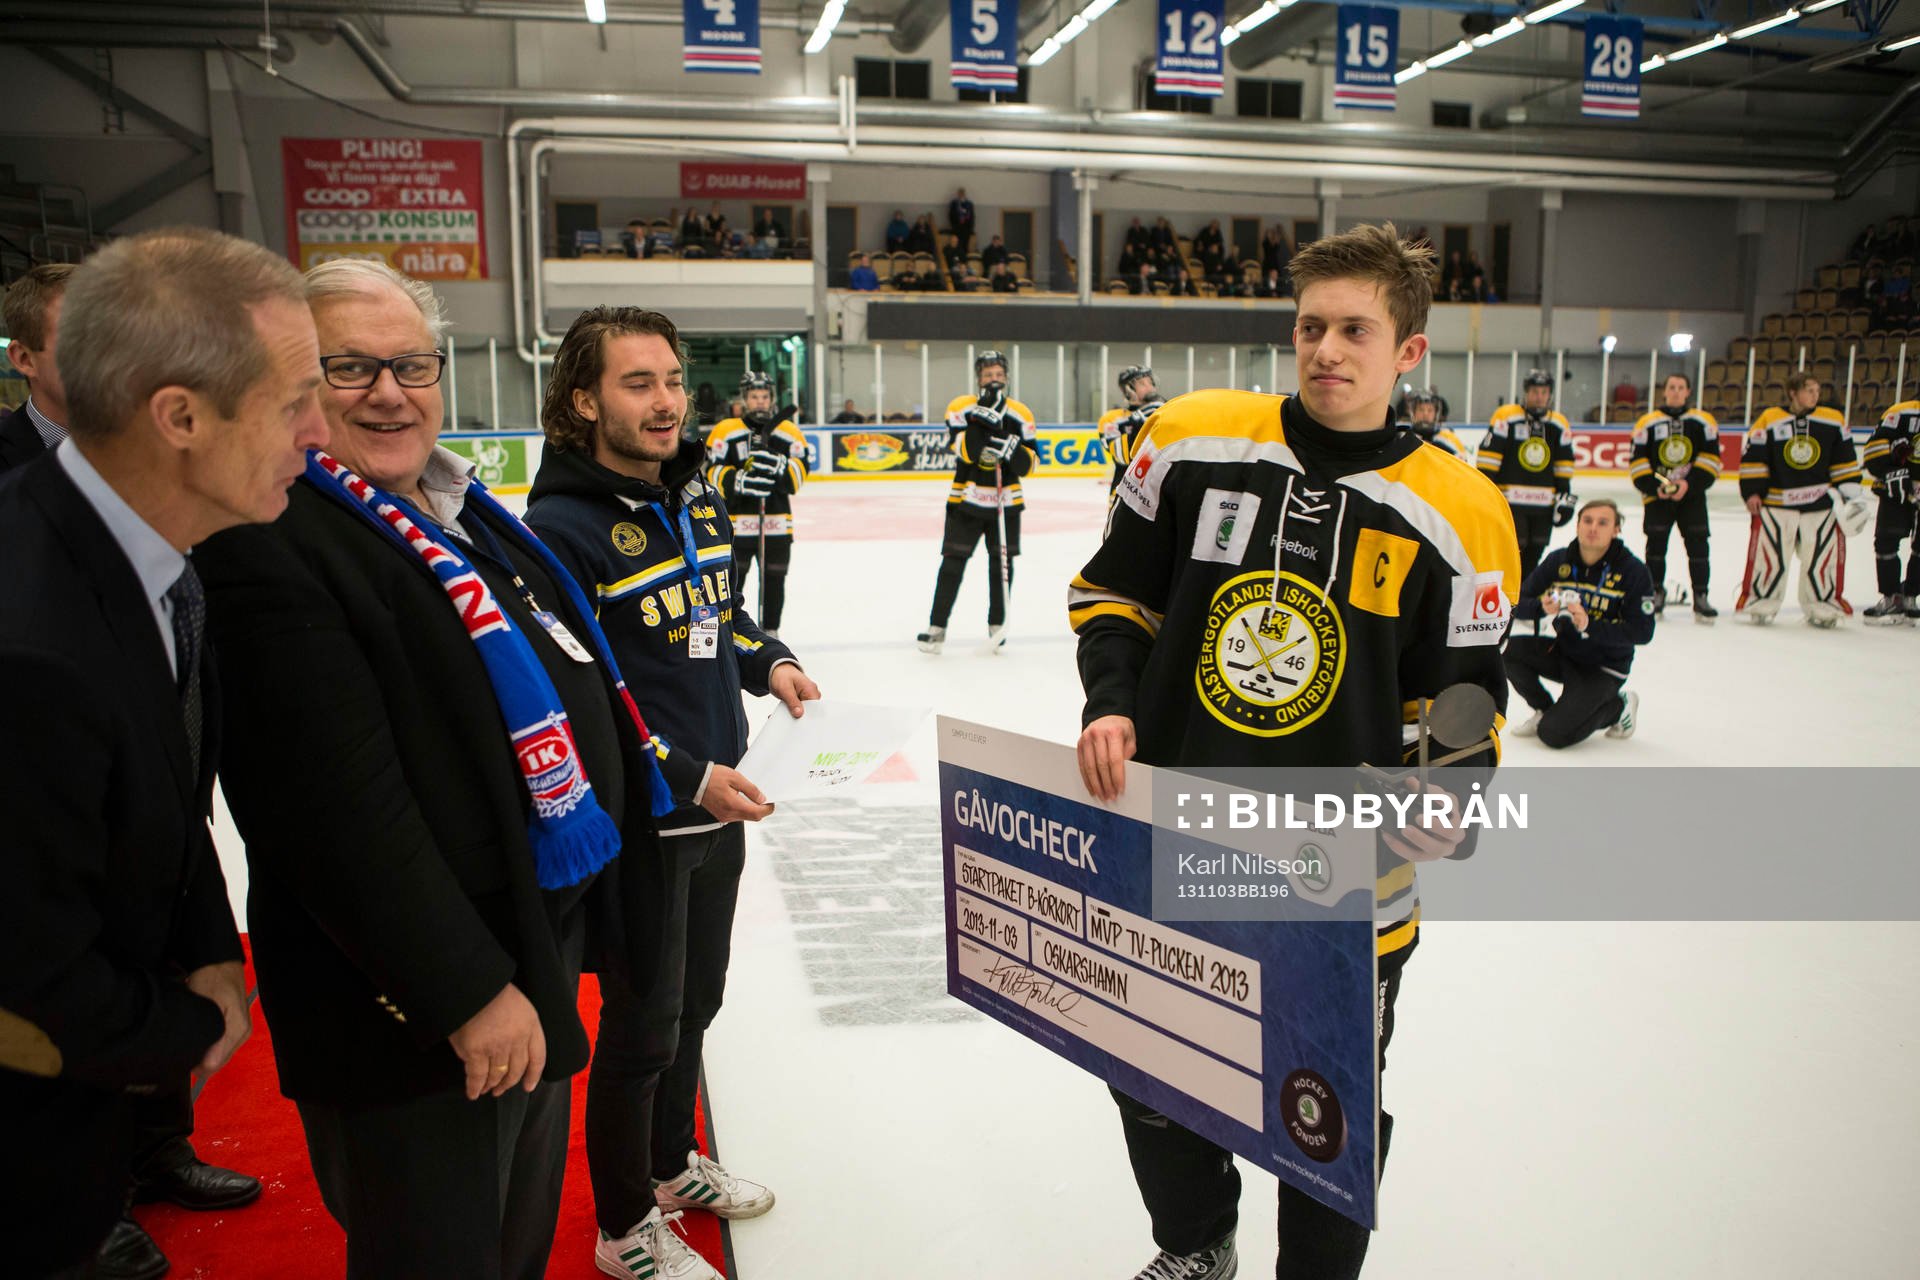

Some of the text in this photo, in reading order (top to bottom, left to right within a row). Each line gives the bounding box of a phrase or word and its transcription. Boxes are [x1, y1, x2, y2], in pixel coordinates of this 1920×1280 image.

[703, 0, 736, 26] 4
[971, 0, 999, 45] 5
[1165, 9, 1217, 55] 12
[1345, 23, 1389, 68] 15
[1590, 34, 1634, 78] 28
[341, 140, 423, 160] PLING!
[706, 173, 803, 193] DUAB-Huset
[304, 188, 466, 207] coop EXTRA
[301, 211, 475, 231] coop KONSUM
[402, 247, 466, 272] nära
[1572, 434, 1631, 469] Sca
[741, 519, 782, 531] Scadic
[1270, 533, 1319, 561] Reebok
[1374, 552, 1390, 589] C
[1456, 623, 1498, 634] SVENSKA
[1201, 583, 1337, 723] VÄSTERGÖTLANDS ISHOCKEYFÖRBUND
[1227, 637, 1246, 653] 19
[1284, 655, 1306, 671] 46
[526, 743, 562, 771] IK
[954, 788, 1099, 874] GÅVOCHECK
[962, 862, 1081, 933] STARTPAKET B-KÖRKORT
[963, 908, 1018, 950] 2013-11-03
[1091, 914, 1249, 1001] MVP TV-PUCKEN 2013
[1044, 940, 1128, 1004] OSKARSHAMN
[1293, 1077, 1329, 1100] HOCKEY
[1291, 1120, 1327, 1147] FONDEN
[1272, 1152, 1353, 1203] www.hockeyfonden.se
